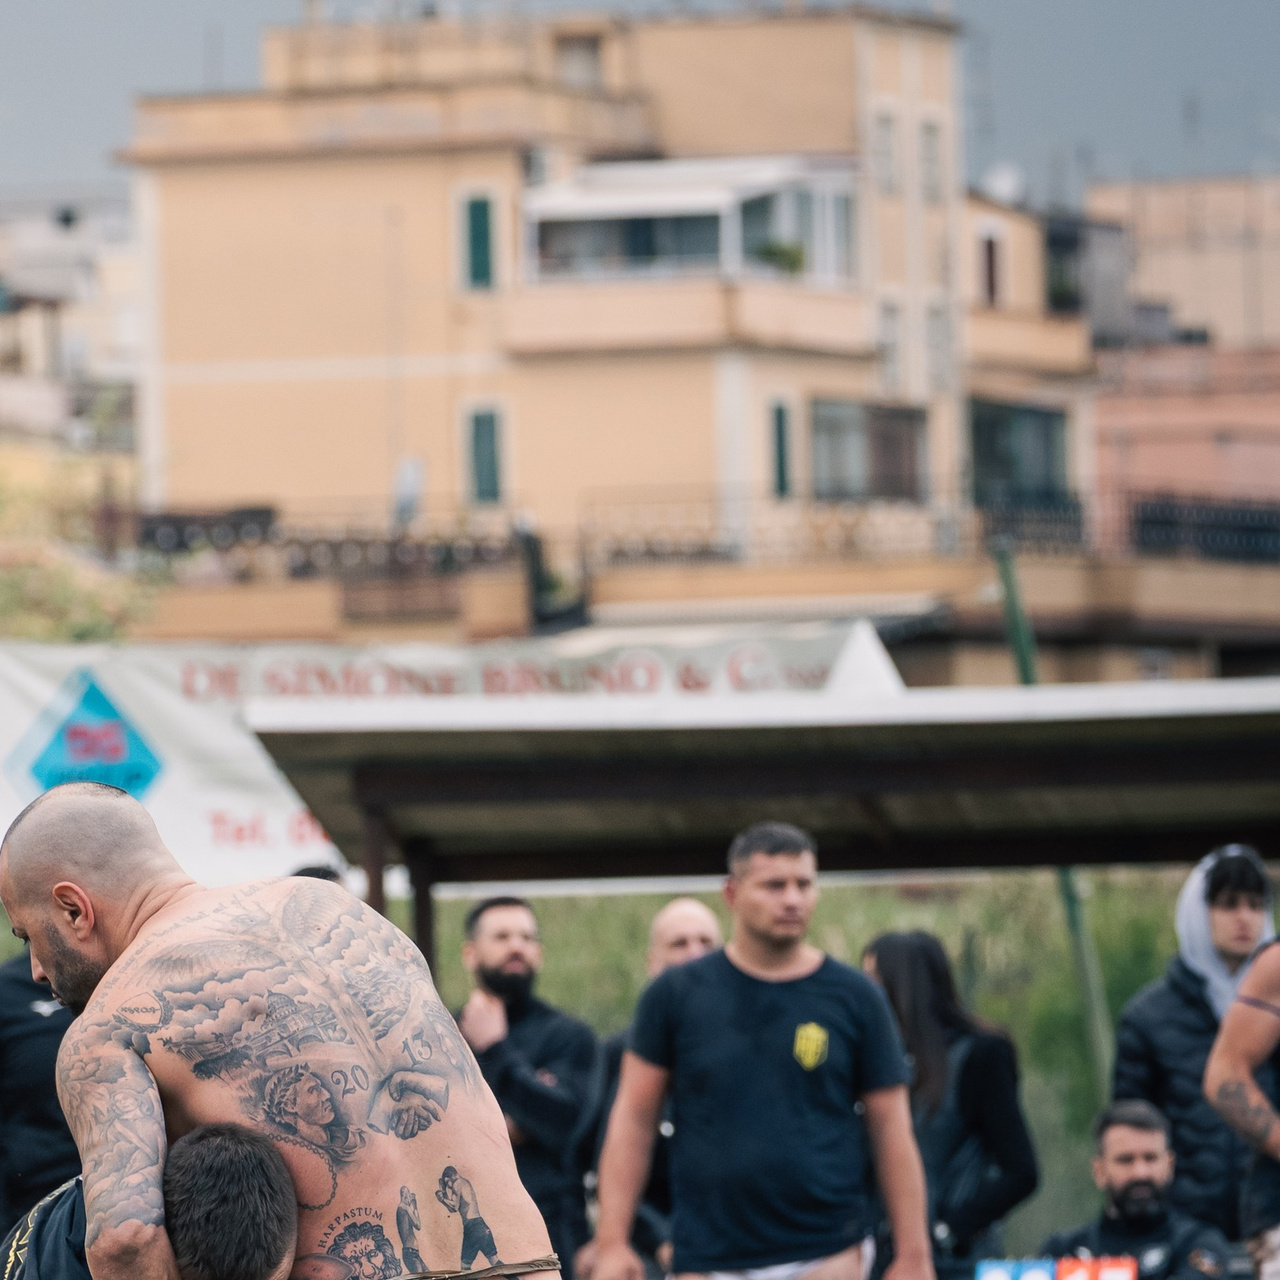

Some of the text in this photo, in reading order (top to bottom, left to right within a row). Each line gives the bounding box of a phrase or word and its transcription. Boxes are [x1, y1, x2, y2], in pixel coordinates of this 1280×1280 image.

[402, 1028, 433, 1068] 13
[331, 1064, 369, 1099] 20
[318, 1207, 383, 1249] HARPASTUM
